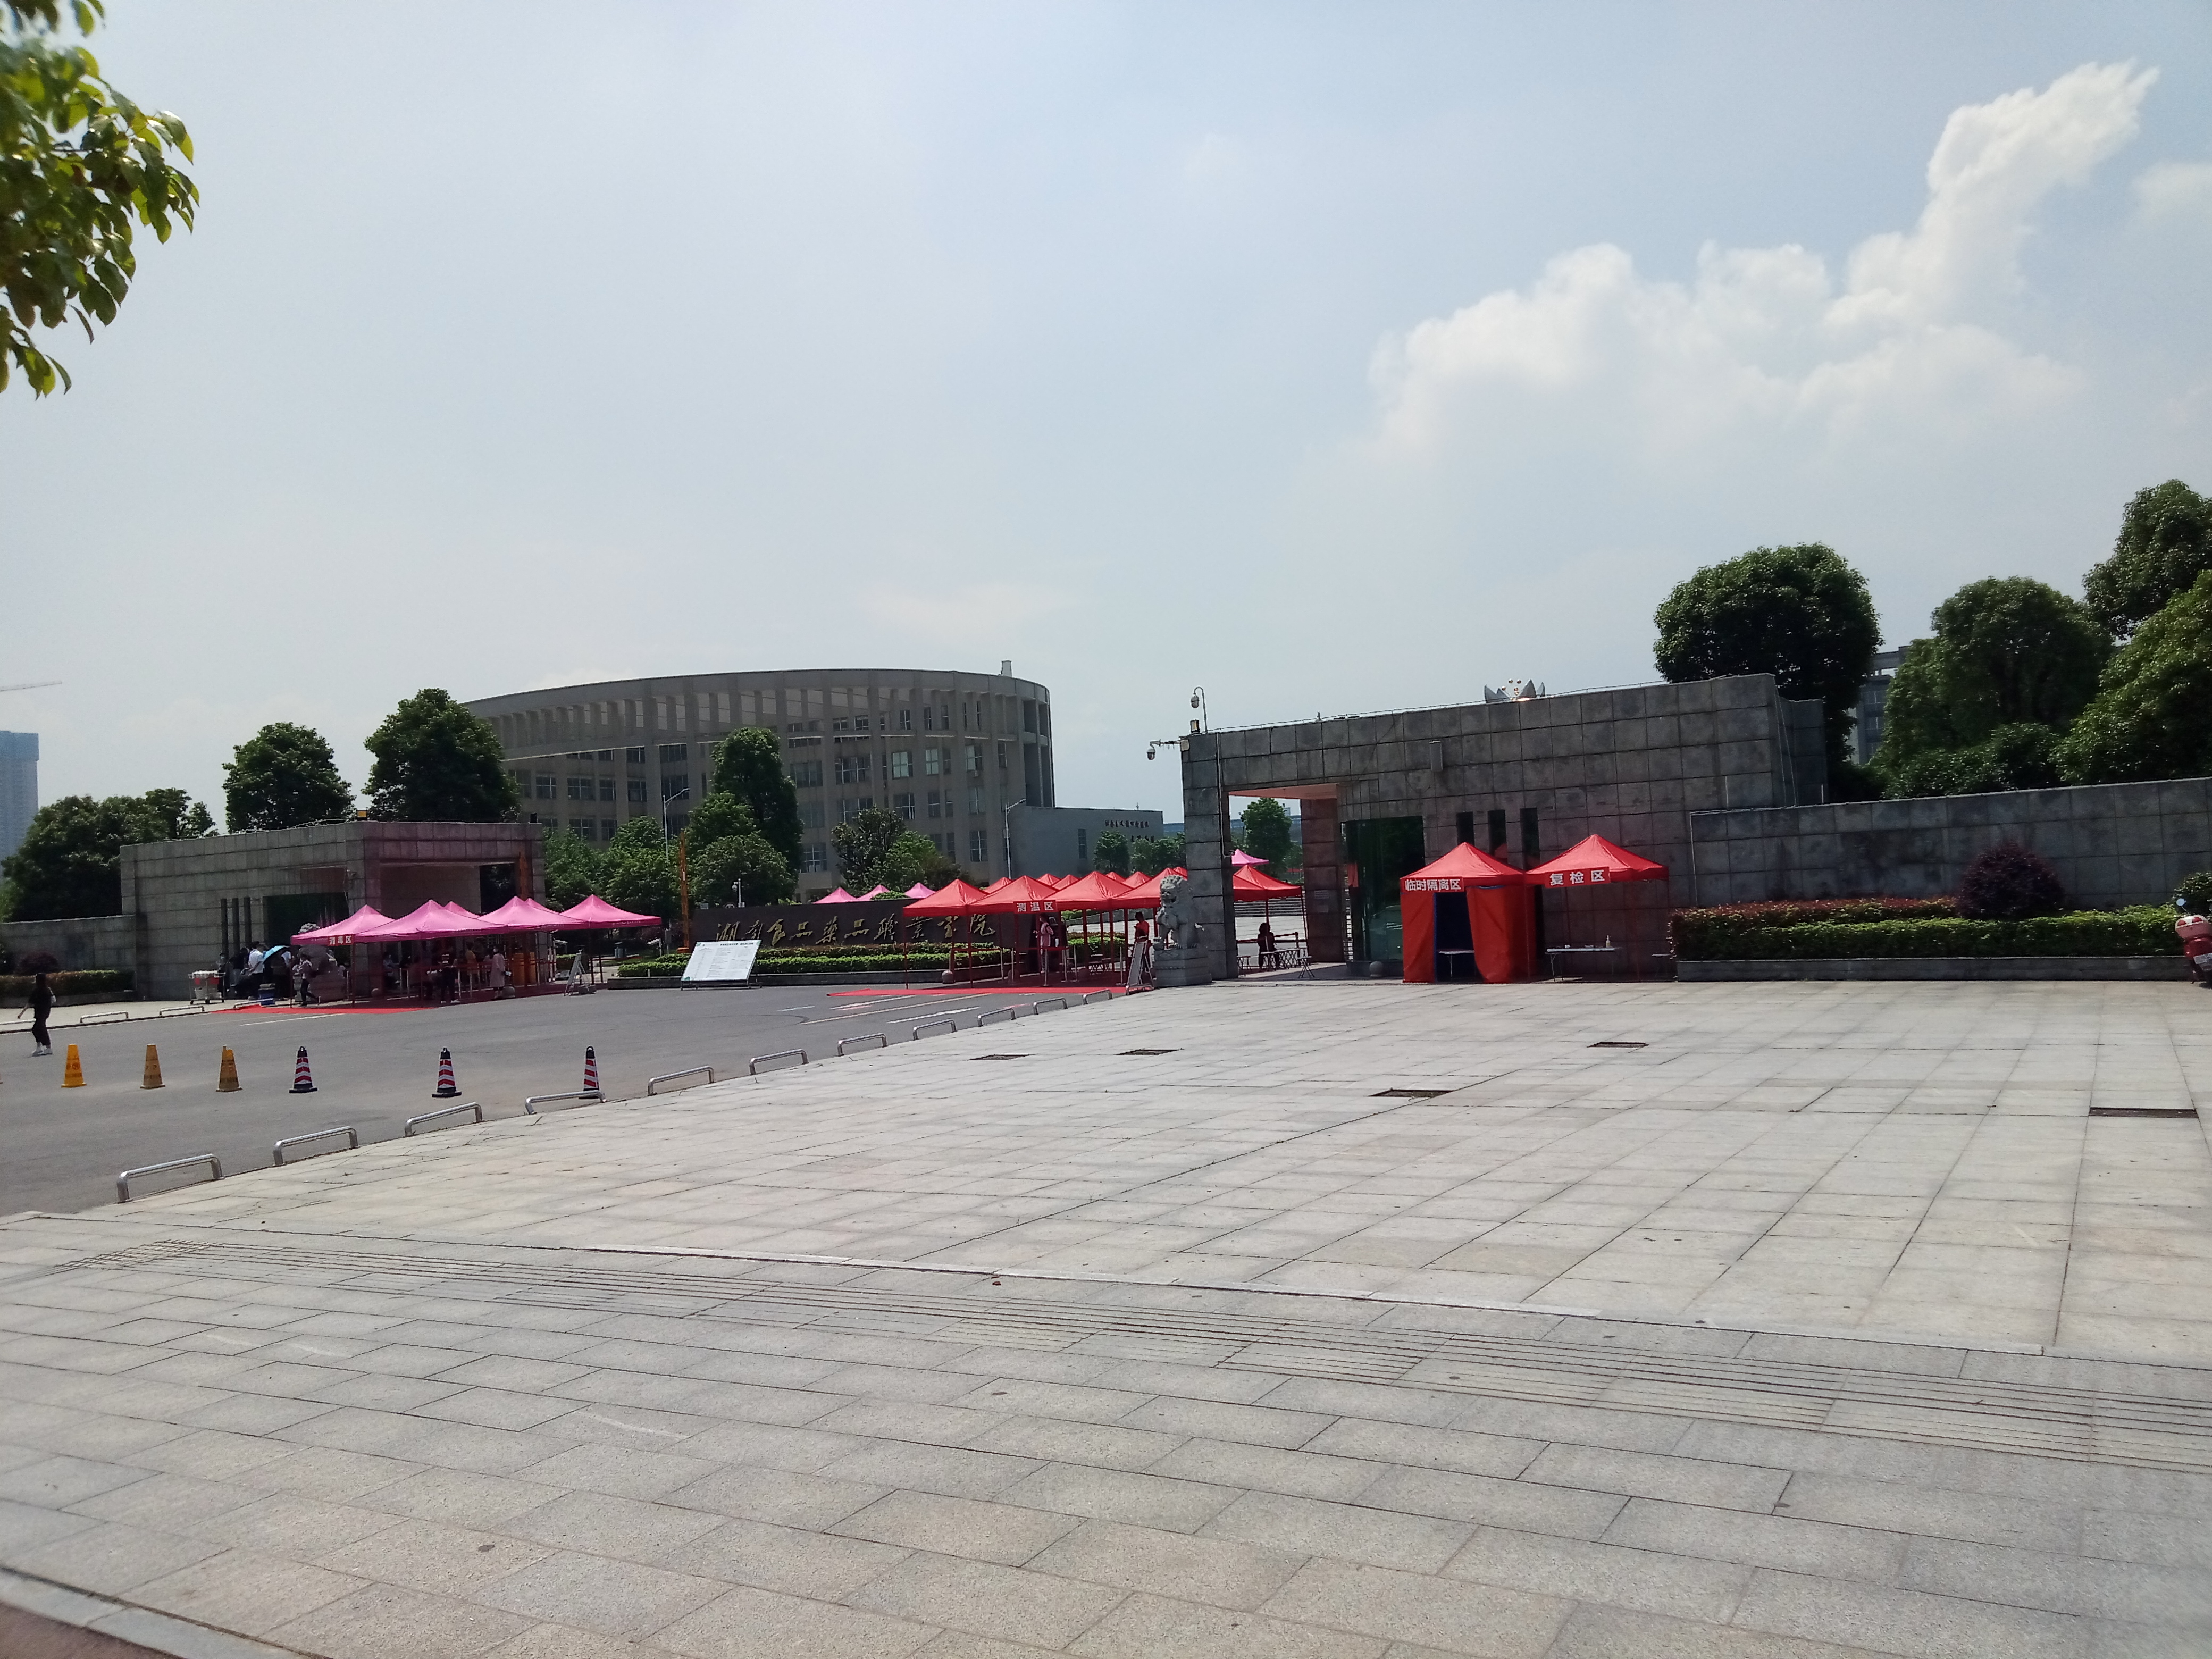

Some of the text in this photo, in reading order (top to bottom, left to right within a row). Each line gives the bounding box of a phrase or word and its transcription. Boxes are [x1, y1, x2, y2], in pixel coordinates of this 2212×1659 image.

[1549, 869, 1605, 886] 复检区
[1404, 878, 1461, 892] 临时隔离区
[1017, 901, 1054, 912] 测温区
